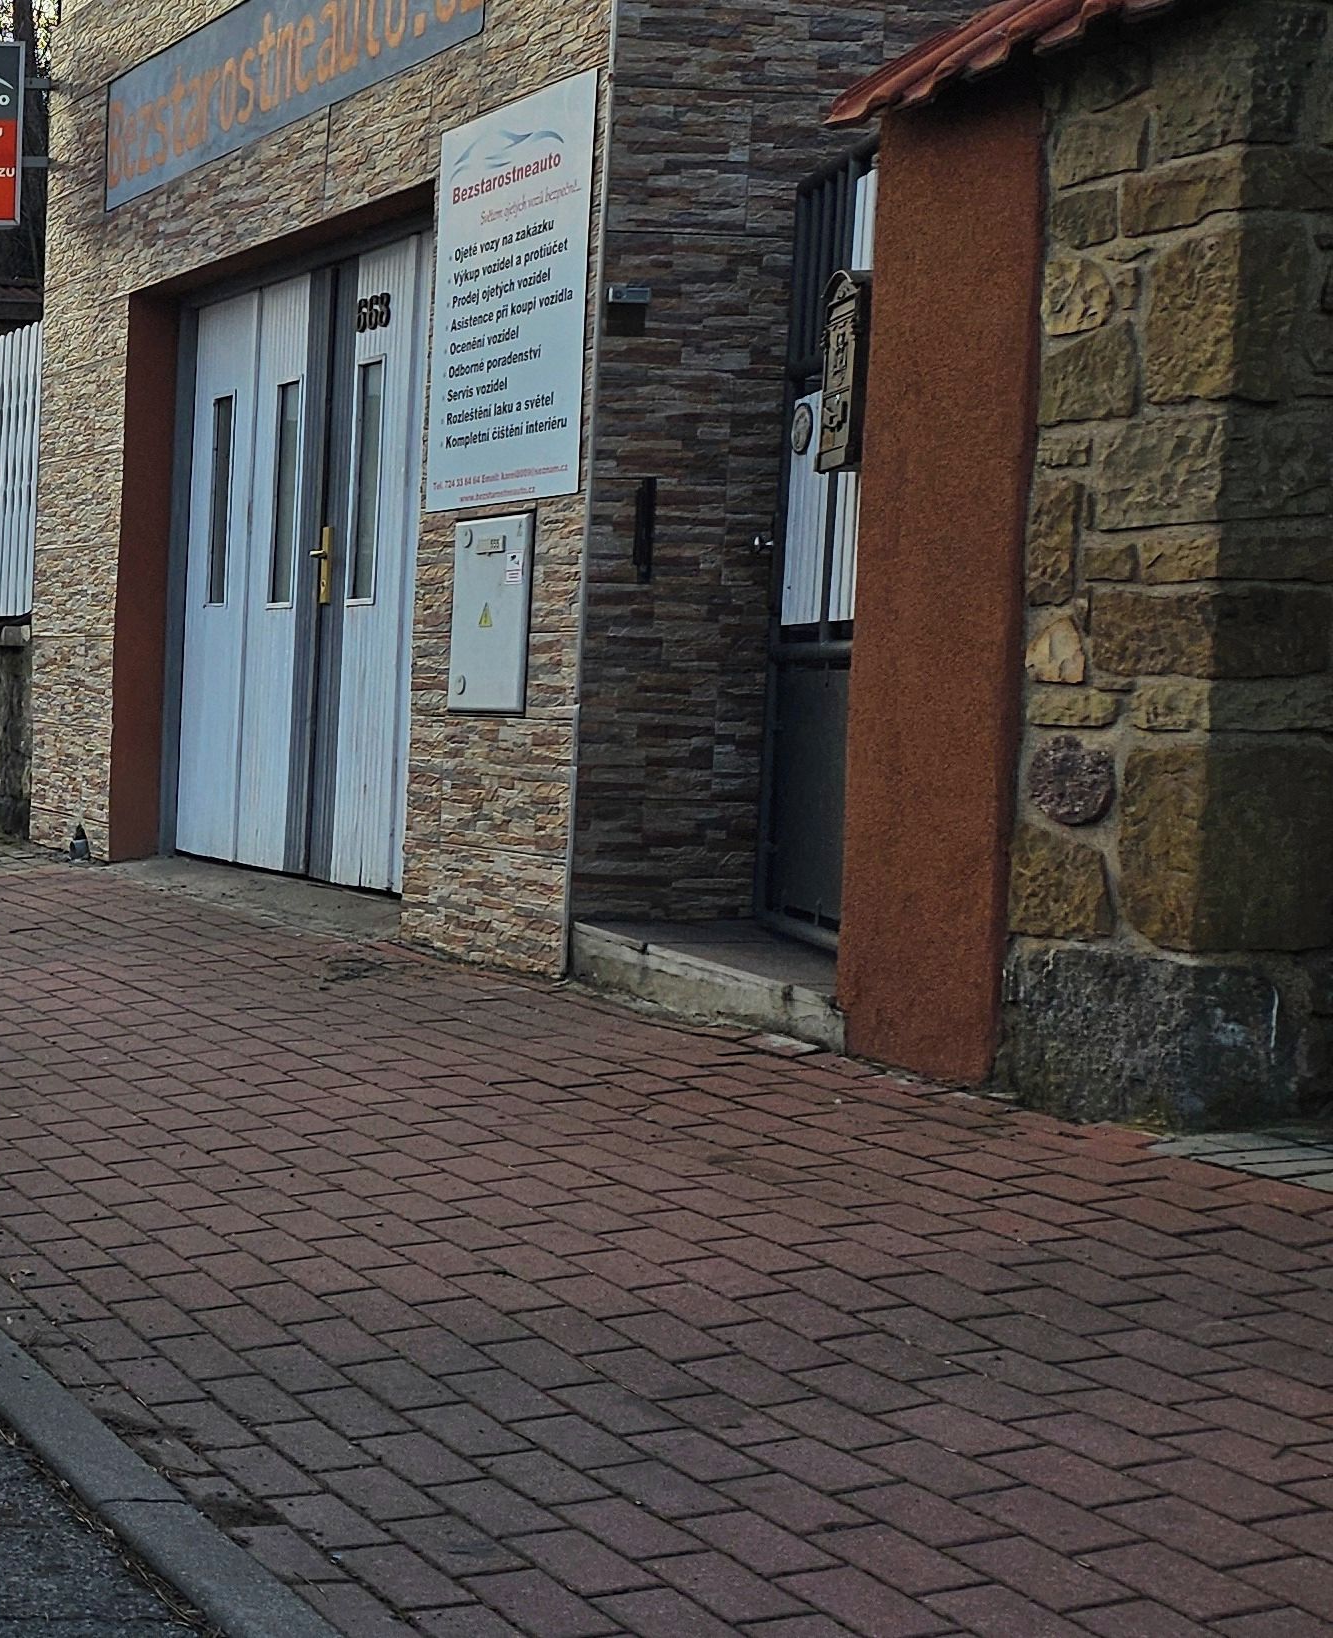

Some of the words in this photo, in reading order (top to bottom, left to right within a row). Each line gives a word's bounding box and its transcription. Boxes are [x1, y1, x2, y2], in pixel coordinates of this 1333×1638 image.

[108, 0, 481, 189] Bezstarostneauto.
[452, 152, 562, 205] Bezstarostneauto
[454, 242, 478, 263] Ojeté
[479, 238, 500, 254] vozy
[501, 233, 513, 246] na
[514, 219, 554, 242] zakázku
[453, 268, 480, 287] Výkup
[482, 254, 513, 276] vozidel
[515, 256, 522, 266] a
[523, 238, 568, 267] protiúčet
[452, 288, 480, 309] Prodej
[481, 278, 515, 300] ojetých
[517, 267, 551, 289] vozidel
[450, 311, 494, 332] Asistence
[495, 303, 509, 323] při
[510, 296, 536, 316] koupi
[538, 287, 573, 308] vozidla
[449, 334, 485, 355] Ocenění
[486, 325, 519, 346] vozidel
[448, 358, 484, 379] Odborné
[486, 344, 542, 373] poradenství
[446, 385, 474, 402] Servis
[475, 377, 508, 396] vozidel
[493, 401, 514, 417] laku
[515, 400, 522, 412] a
[524, 391, 554, 410] světel
[445, 426, 490, 449] Kompletní
[491, 422, 523, 441] čištění
[525, 415, 568, 435] interiéru
